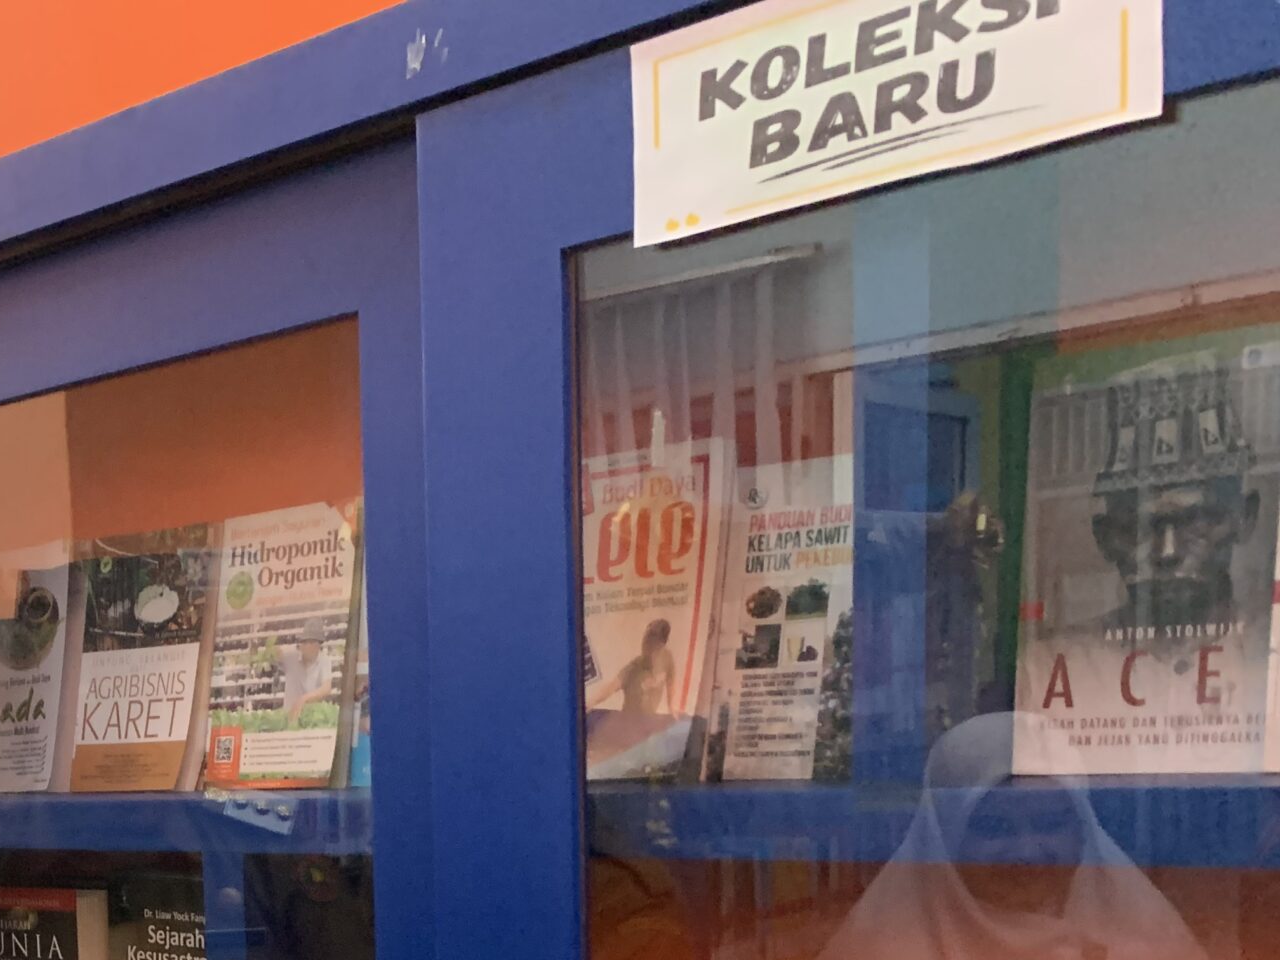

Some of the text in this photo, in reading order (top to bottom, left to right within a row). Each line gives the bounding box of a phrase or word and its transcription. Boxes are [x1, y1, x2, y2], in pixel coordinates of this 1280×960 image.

[749, 48, 997, 169] BARU
[749, 510, 816, 533] PANDUAN
[228, 529, 346, 568] Hidroponik
[583, 501, 695, 584] ele
[747, 525, 850, 553] KELAPA SAWIT
[258, 555, 344, 590] Organik
[745, 552, 792, 574] UNTUK
[1104, 627, 1155, 641] ANTON
[86, 670, 187, 700] AGRIBISNIS
[81, 697, 185, 741] KARET
[147, 925, 205, 950] Sejarah
